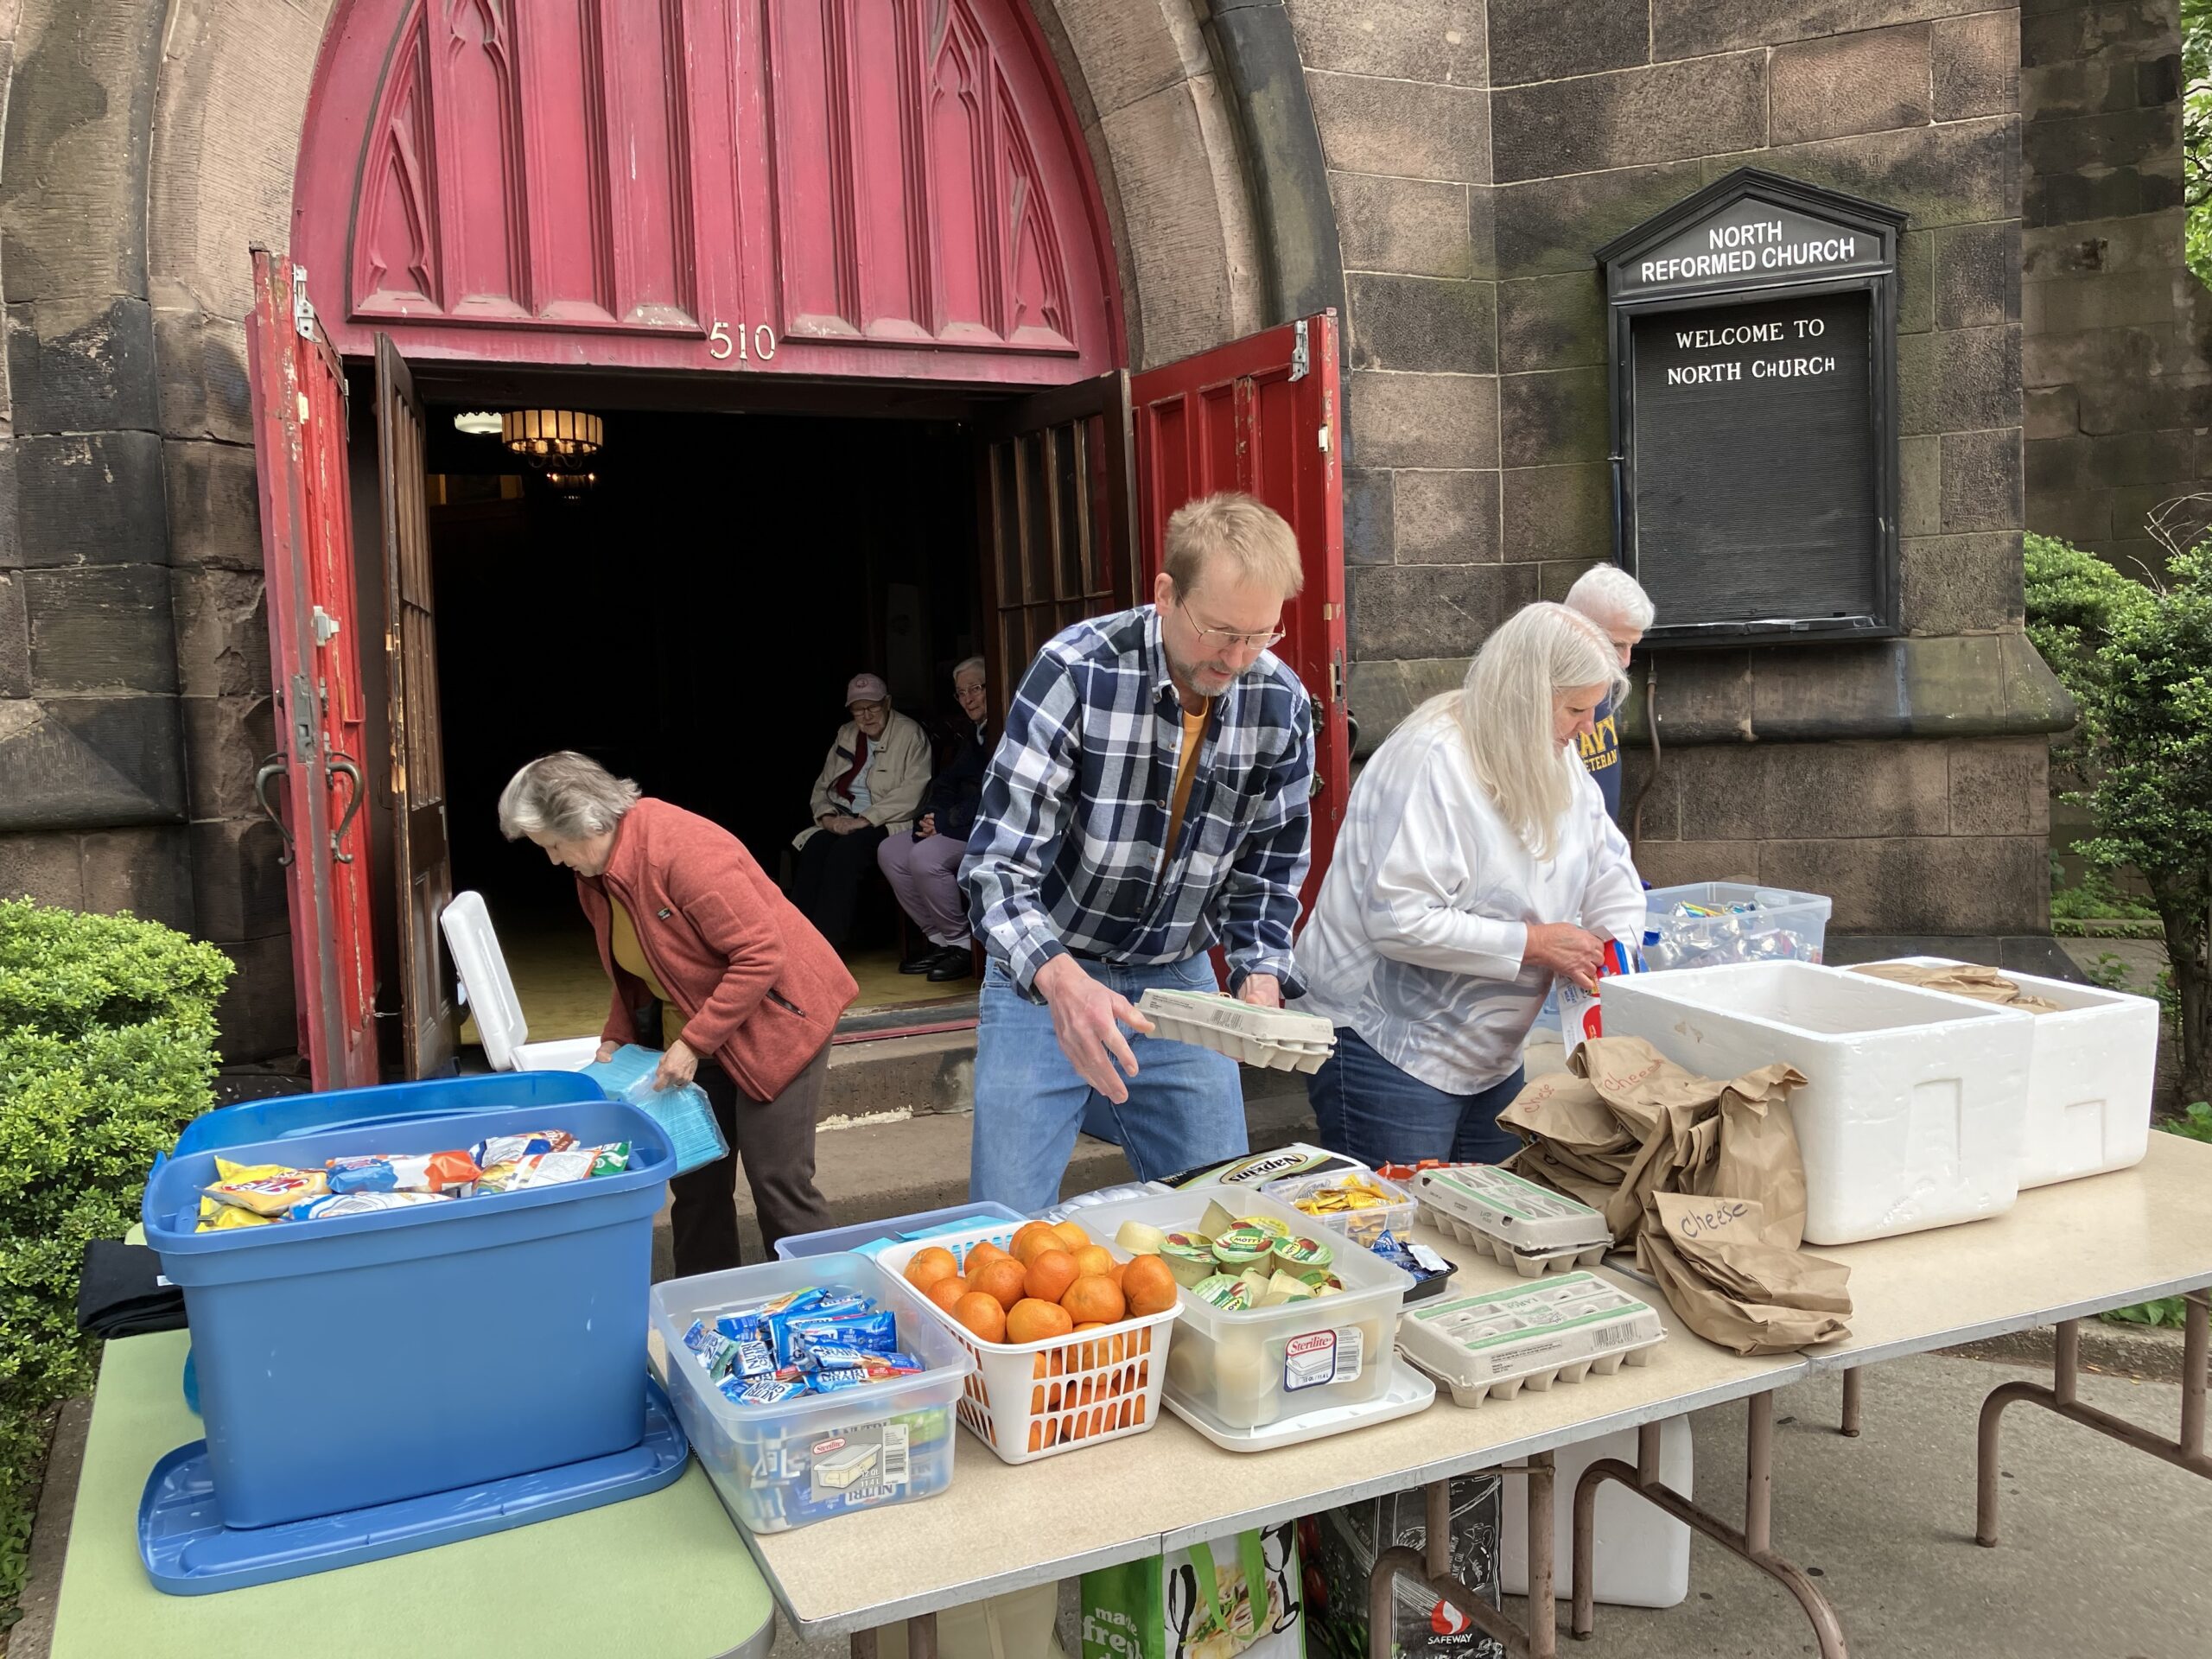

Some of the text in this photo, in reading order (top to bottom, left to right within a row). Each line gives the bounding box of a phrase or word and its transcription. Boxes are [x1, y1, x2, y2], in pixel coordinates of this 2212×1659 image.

[1709, 220, 1782, 250] NORTH
[1642, 237, 1855, 283] REFORMED CHURCH
[709, 321, 776, 360] 510
[1675, 318, 1825, 349] WELCOME TO
[1667, 356, 1835, 385] NORTH CHURCH
[1579, 715, 1618, 758] AVY
[1583, 748, 1618, 772] ETERAN
[1229, 1154, 1303, 1183] Napkins
[1681, 1203, 1749, 1238] Cheese
[1290, 1336, 1329, 1353] Sterilite
[817, 1439, 842, 1452] Sterilite
[1427, 1633, 1473, 1645] SAFEWAY
